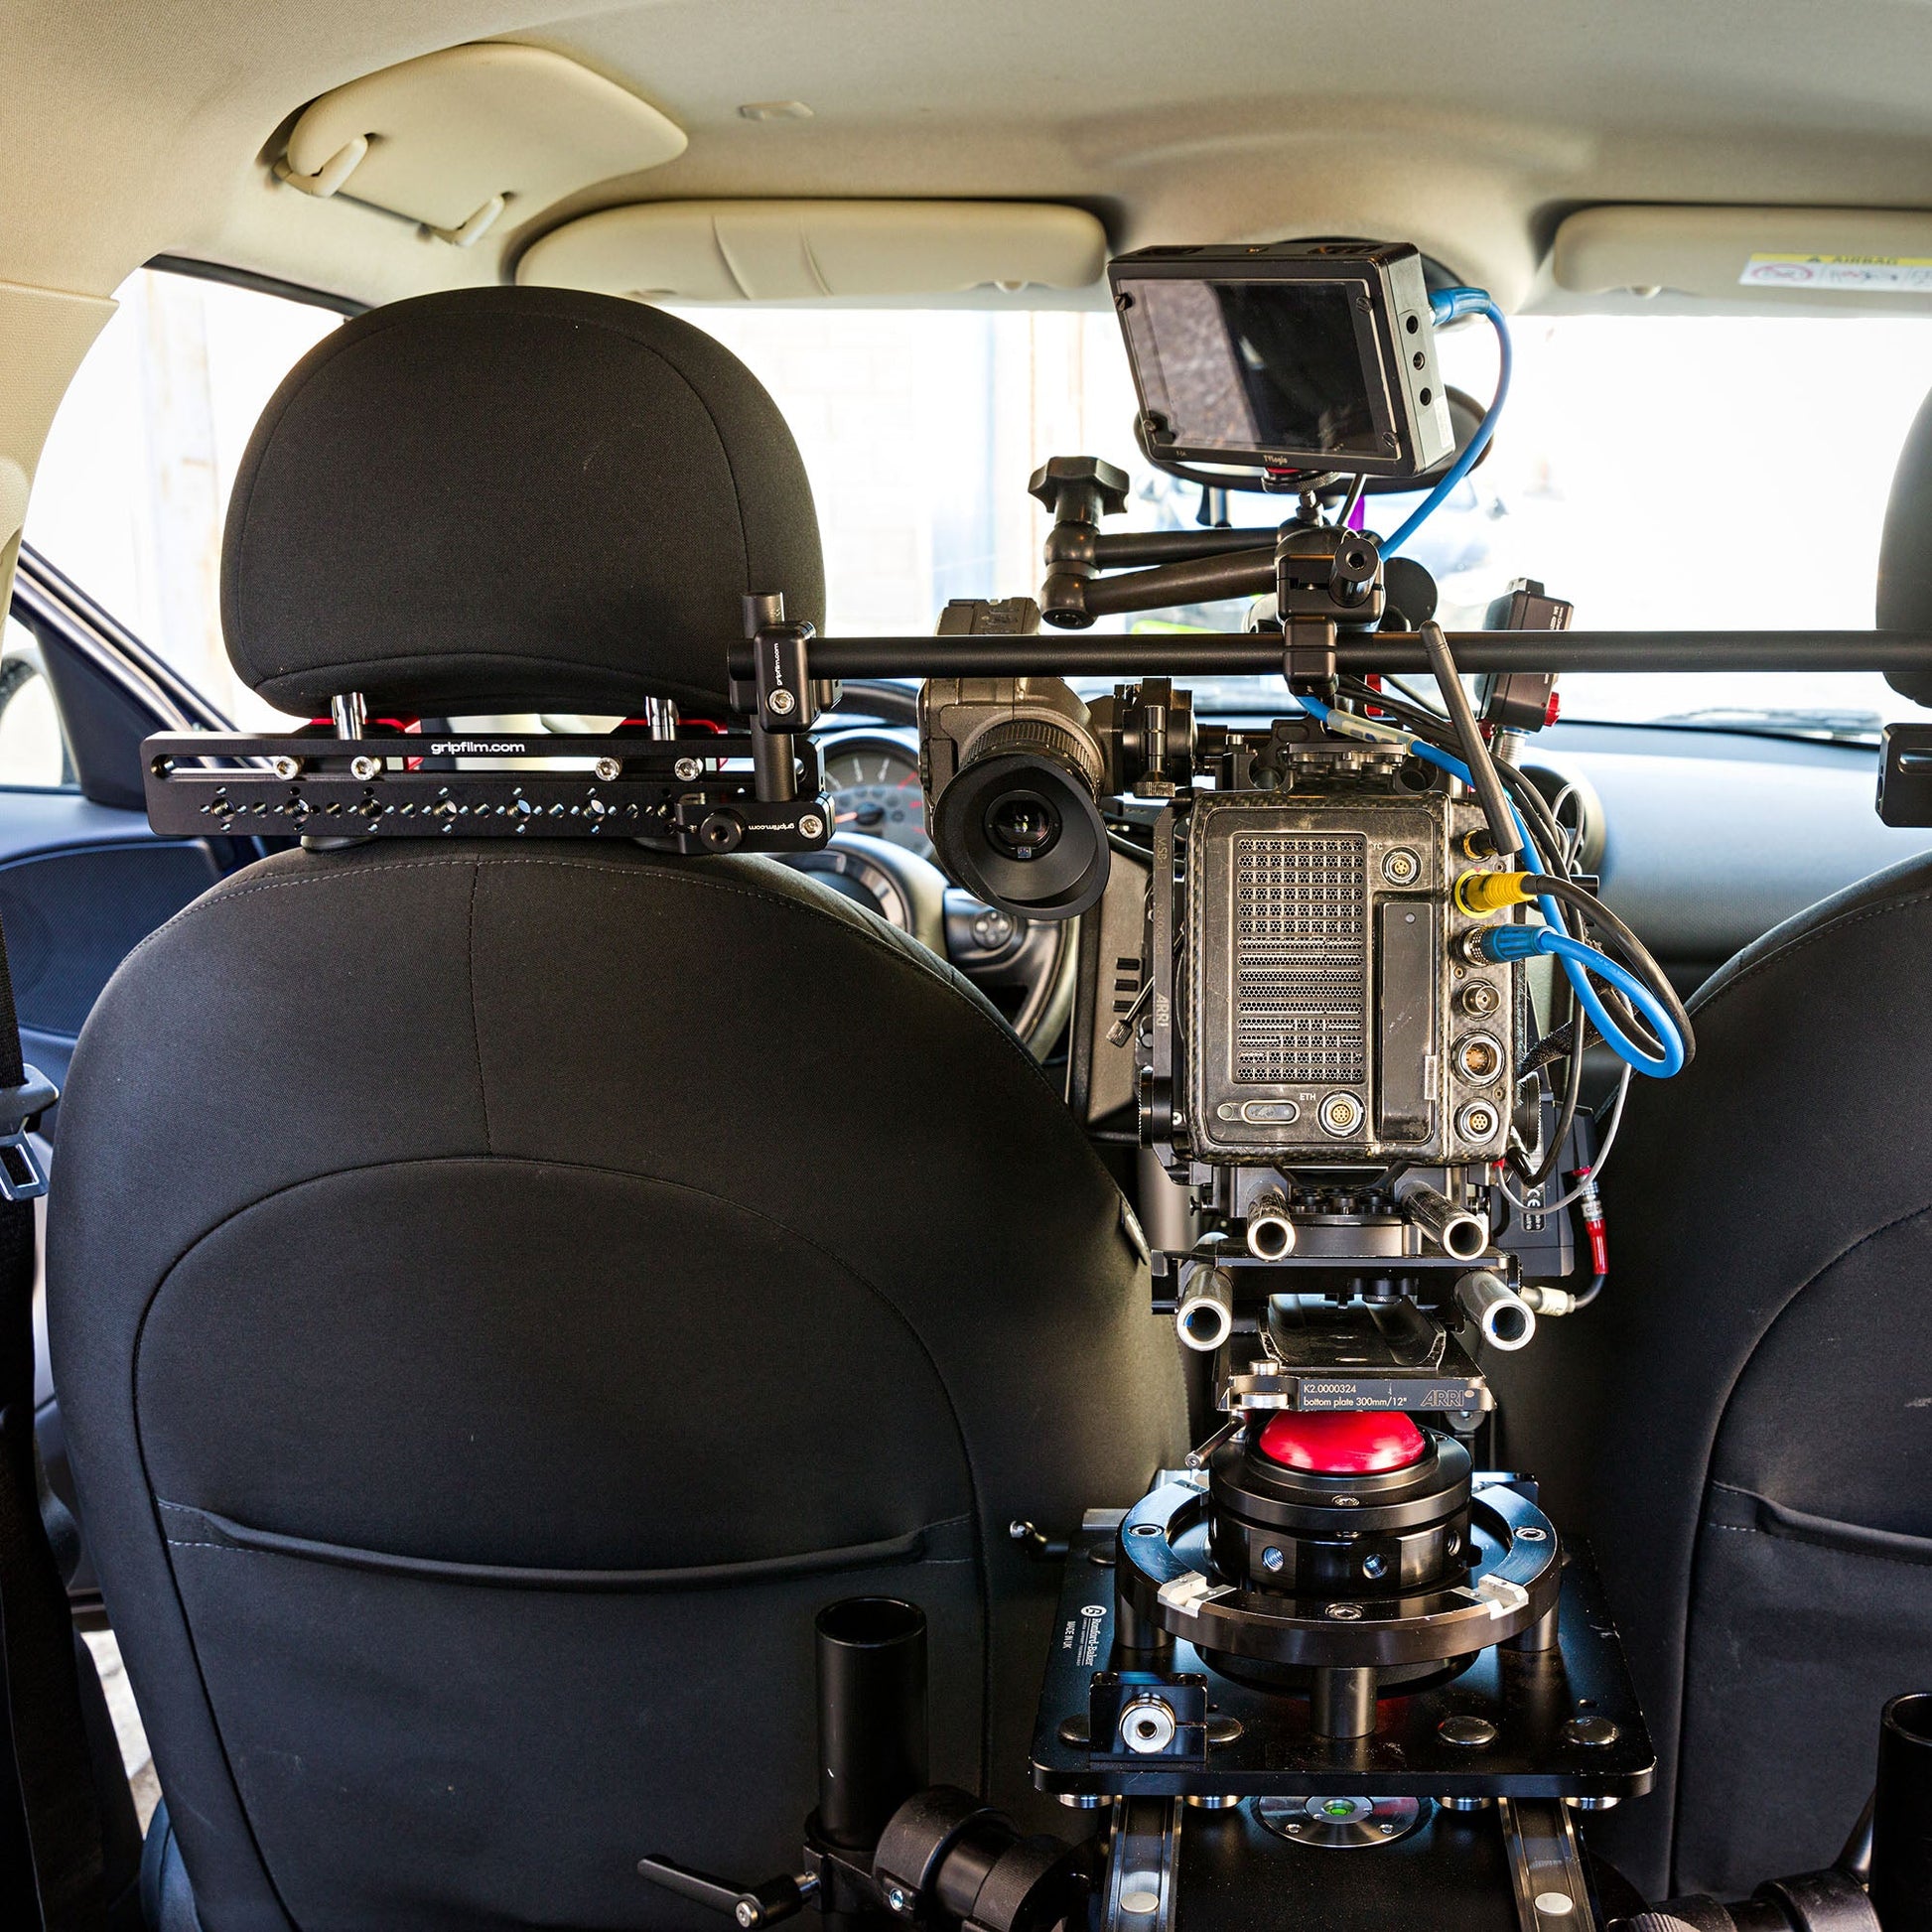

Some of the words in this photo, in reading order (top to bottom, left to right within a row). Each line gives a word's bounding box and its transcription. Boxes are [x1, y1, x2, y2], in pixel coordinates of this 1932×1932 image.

[774, 642, 783, 686] gripfilm.com
[430, 742, 526, 755] gripfilm.com
[748, 822, 795, 831] gripfilm.com
[1156, 993, 1170, 1027] ARRI
[1300, 1092, 1316, 1101] ETH
[1304, 1384, 1356, 1394] K2.0000324
[1304, 1396, 1331, 1407] bottom
[1333, 1396, 1354, 1408] plate
[1355, 1396, 1407, 1407] 300mm/12"
[1420, 1390, 1464, 1407] ARRI
[1066, 1621, 1076, 1635] MADE
